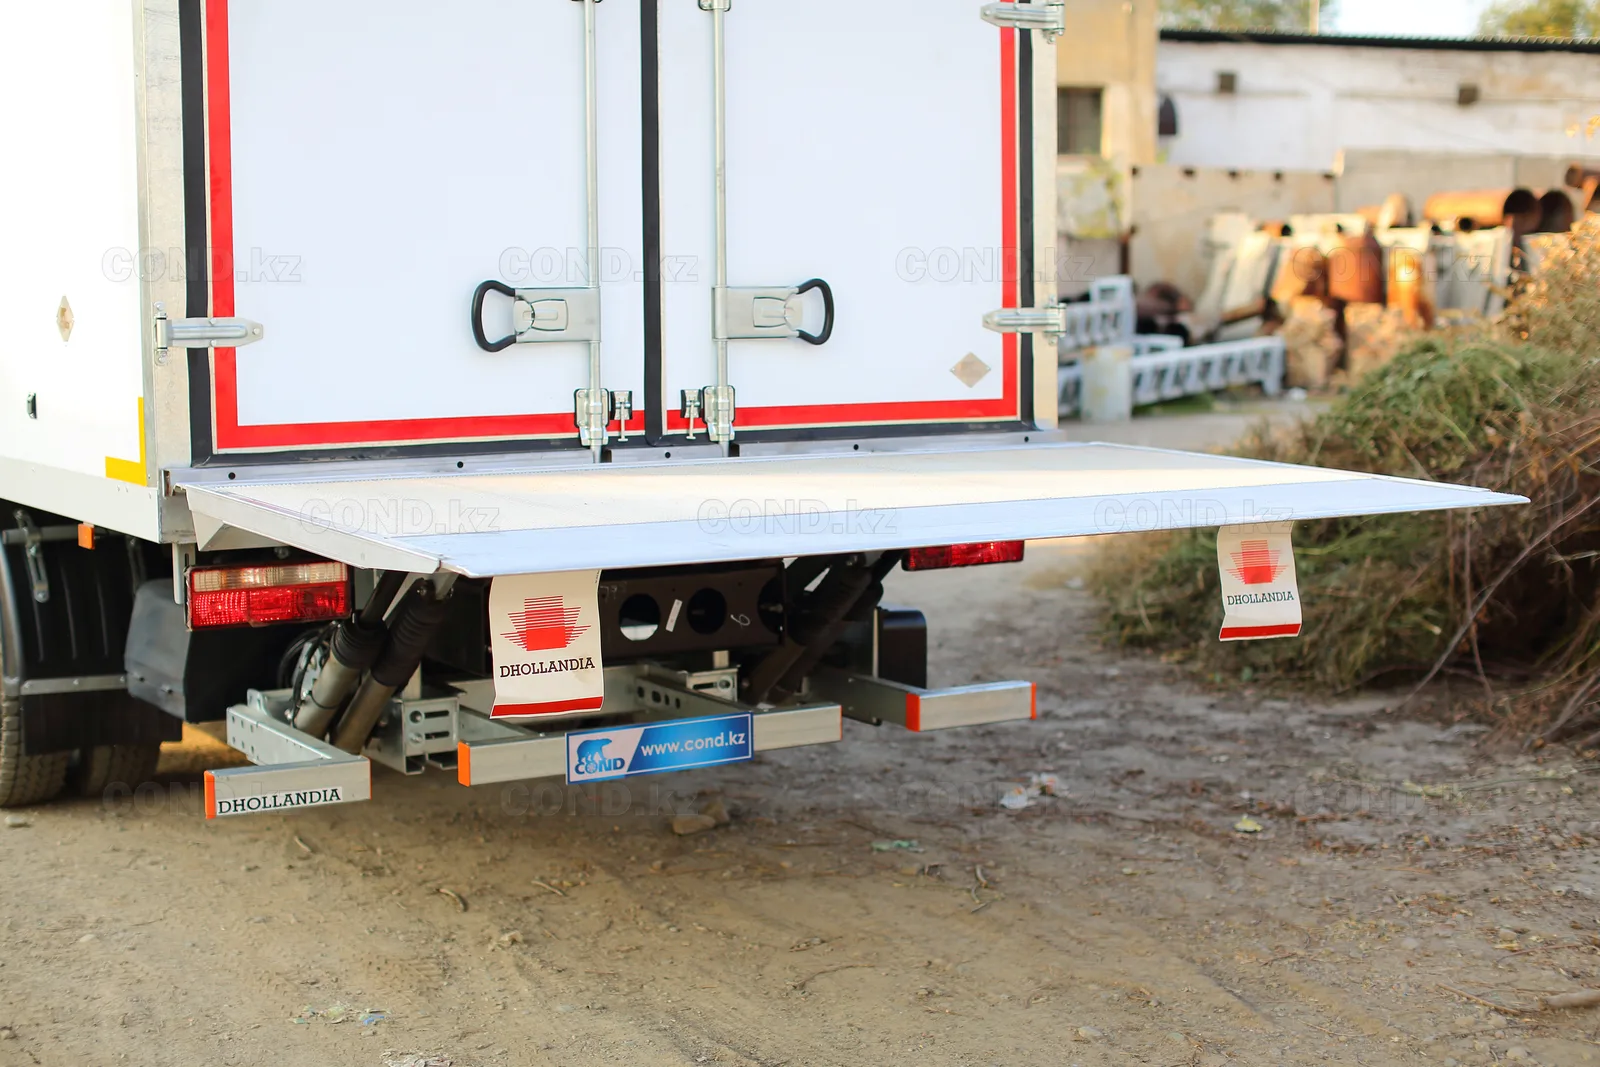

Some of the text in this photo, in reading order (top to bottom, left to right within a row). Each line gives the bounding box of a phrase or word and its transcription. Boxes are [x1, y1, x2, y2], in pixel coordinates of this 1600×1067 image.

[1227, 591, 1294, 606] DHOLLANDIA
[500, 656, 595, 678] DHOLLANDIA
[641, 731, 746, 757] www.cond.kz
[574, 757, 625, 775] COND
[217, 788, 341, 815] DHOLLANDIA
